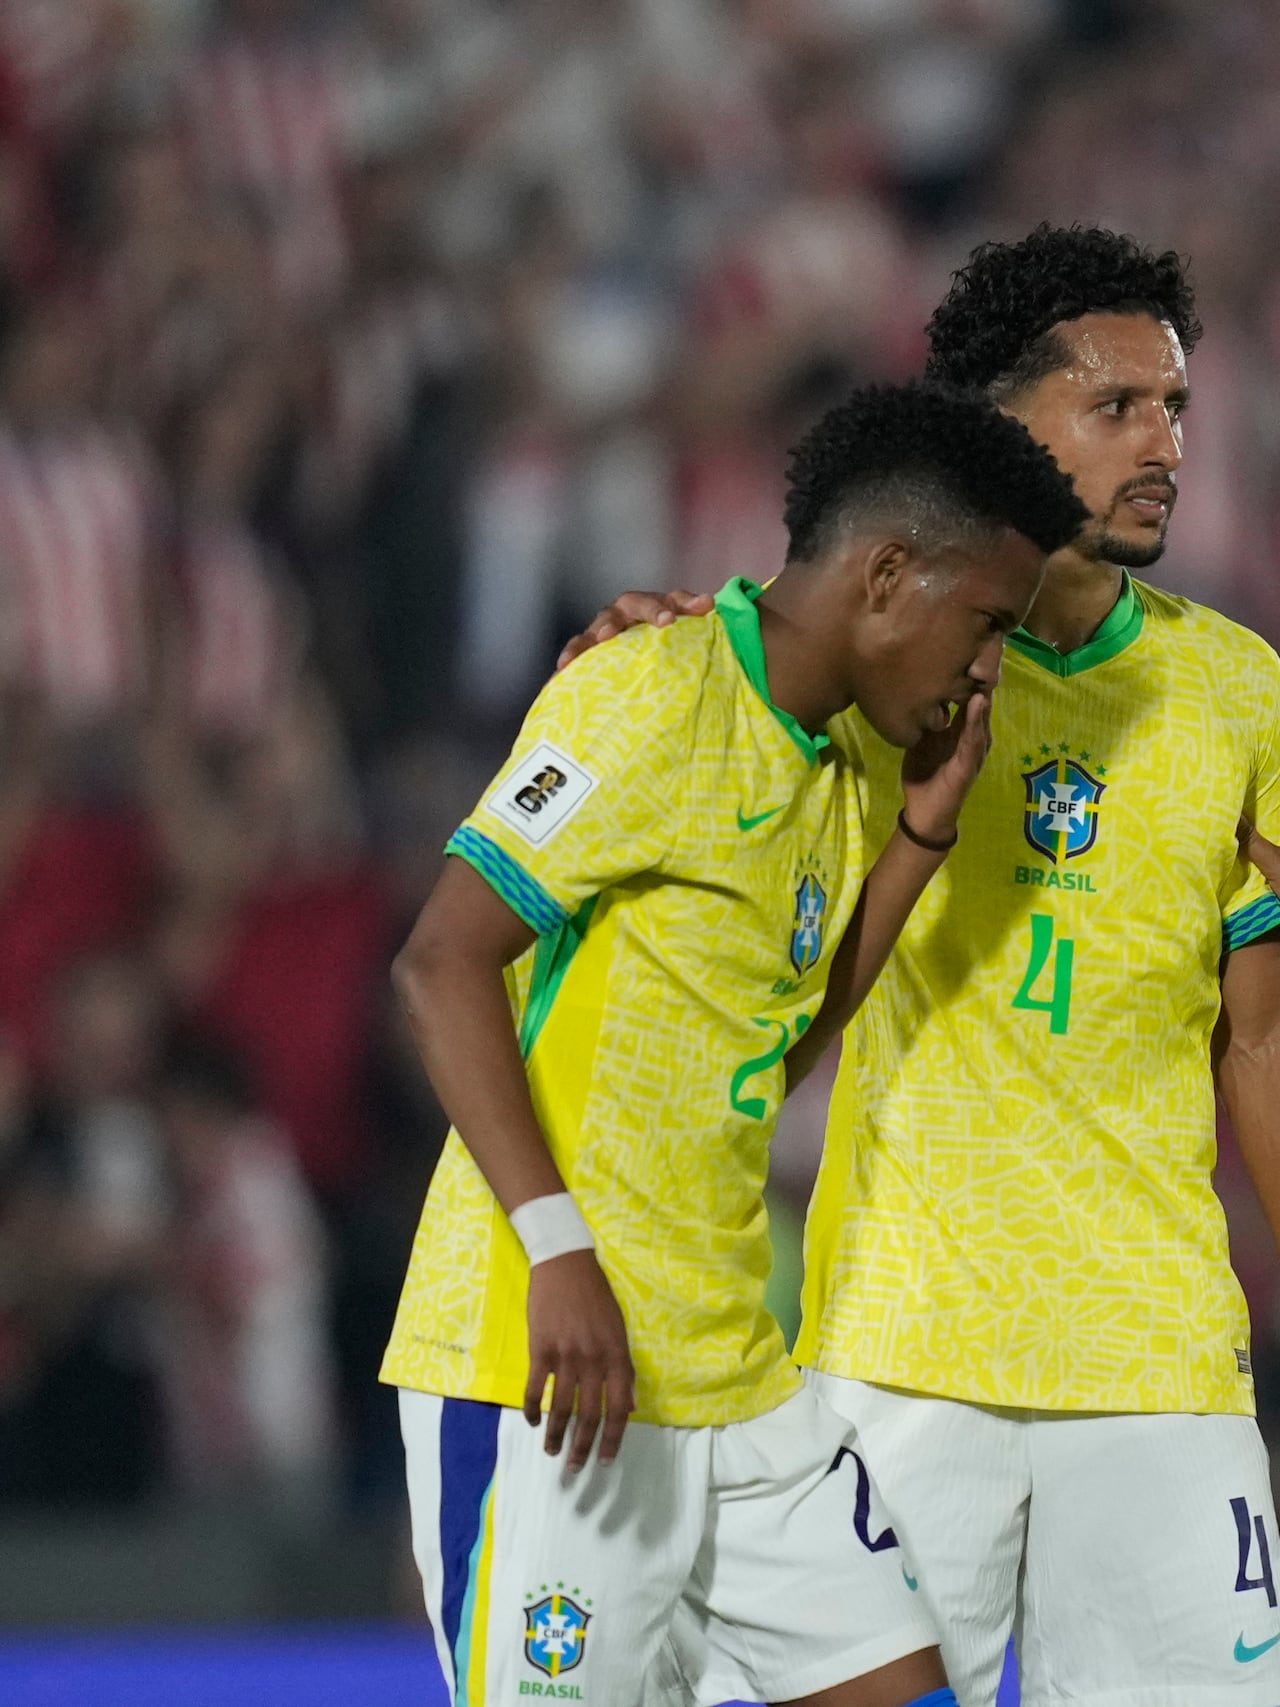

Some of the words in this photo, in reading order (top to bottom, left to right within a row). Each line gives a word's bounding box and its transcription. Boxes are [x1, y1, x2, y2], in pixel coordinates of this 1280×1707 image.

[1047, 800, 1077, 815] CBF
[1014, 865, 1098, 893] BRASIL
[1011, 913, 1074, 1035] 4
[1229, 1496, 1278, 1609] 4
[543, 1628, 568, 1640] CBF
[519, 1681, 585, 1700] BRASIL
